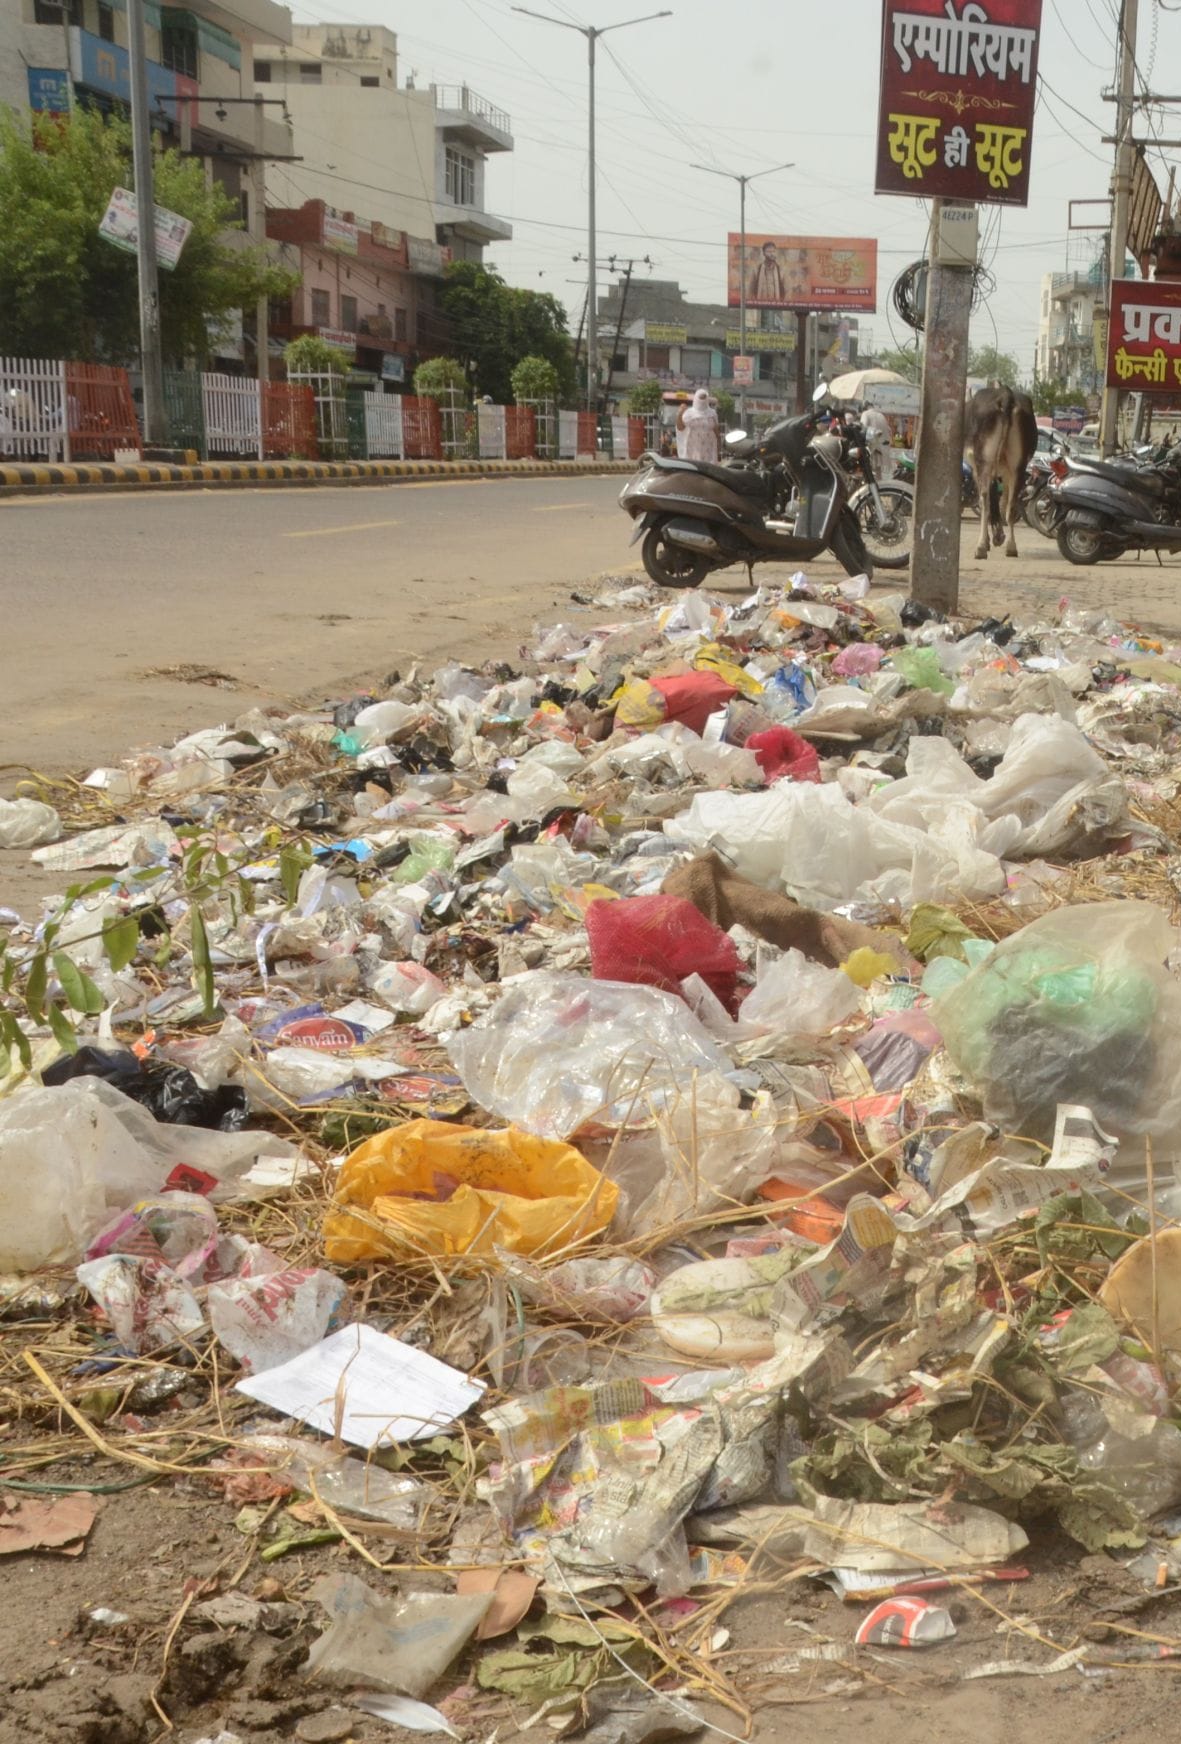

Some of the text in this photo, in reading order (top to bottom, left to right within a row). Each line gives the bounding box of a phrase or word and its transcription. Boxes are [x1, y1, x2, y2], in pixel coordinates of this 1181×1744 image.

[893, 0, 1036, 84] एम्पोरियम
[888, 113, 1027, 188] सूट ही सूट
[1114, 347, 1167, 384] फैन्सी
